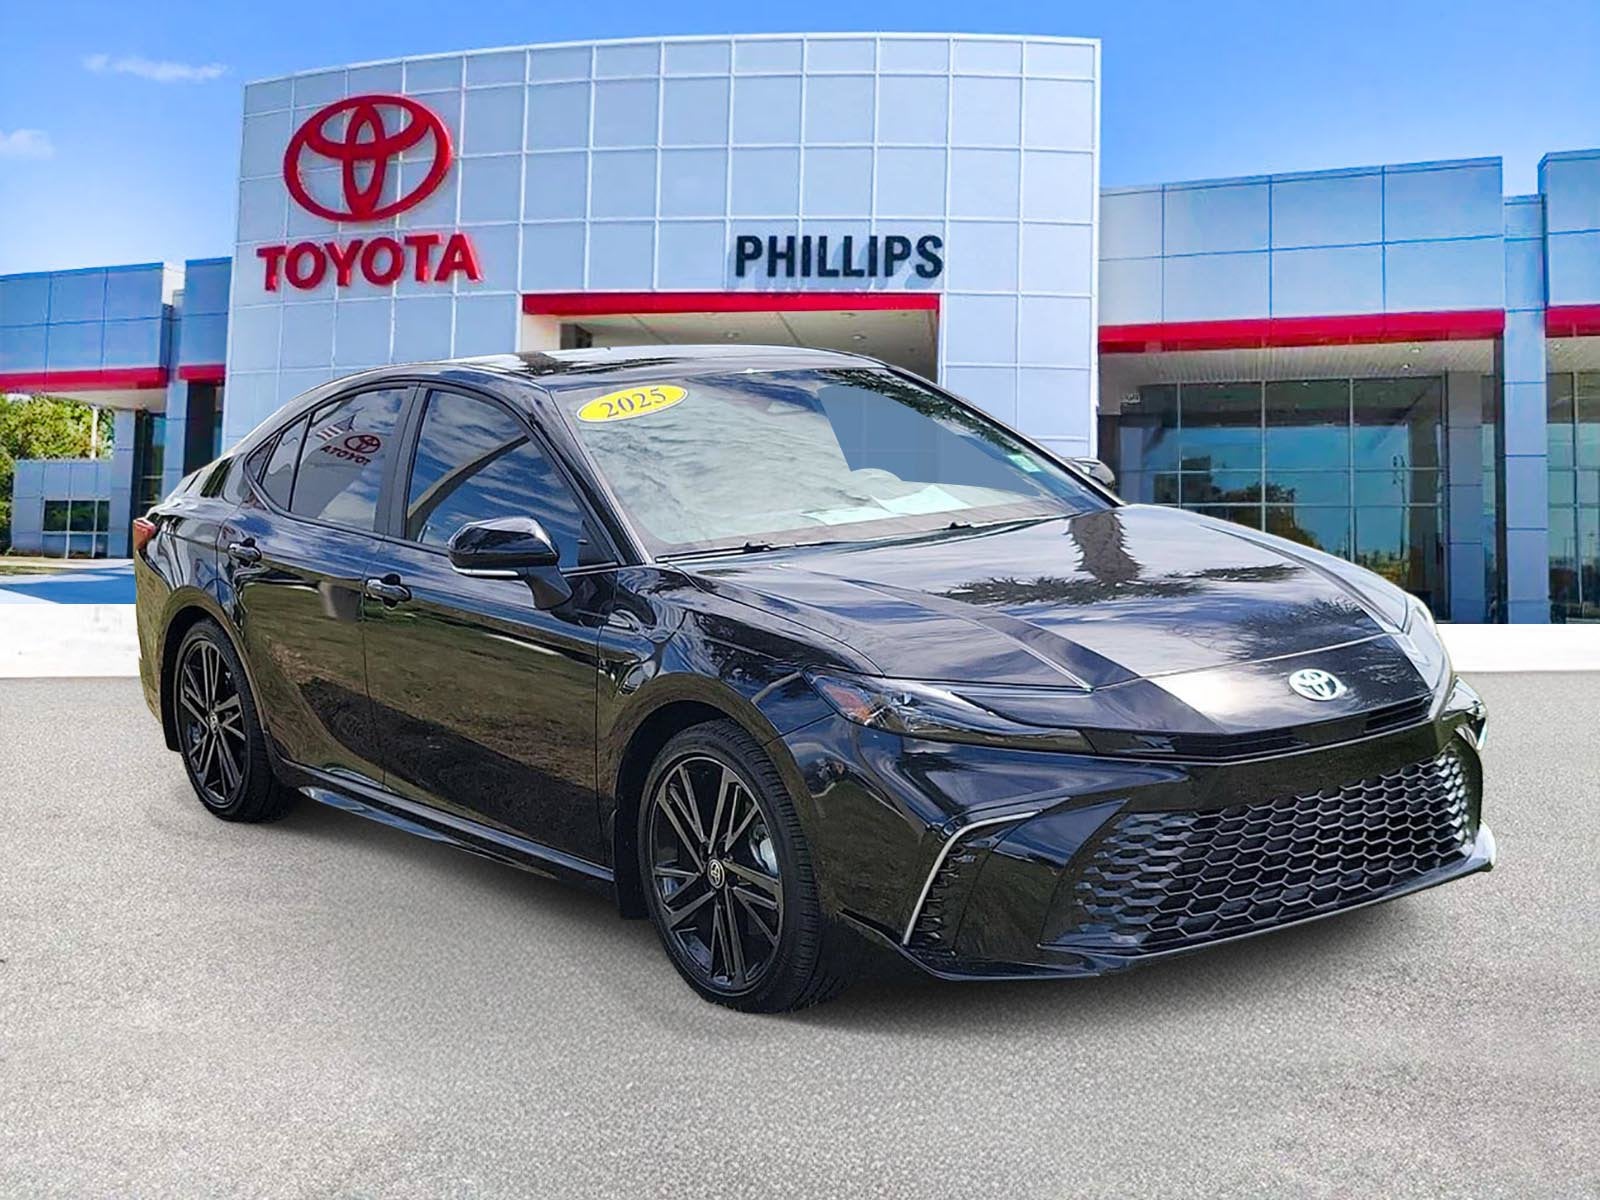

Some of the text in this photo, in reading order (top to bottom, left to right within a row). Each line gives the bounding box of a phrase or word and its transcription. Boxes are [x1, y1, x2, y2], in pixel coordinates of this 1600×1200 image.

[257, 233, 482, 291] TOYOTA
[735, 235, 943, 279] PHILLIPS
[600, 388, 667, 418] 2025
